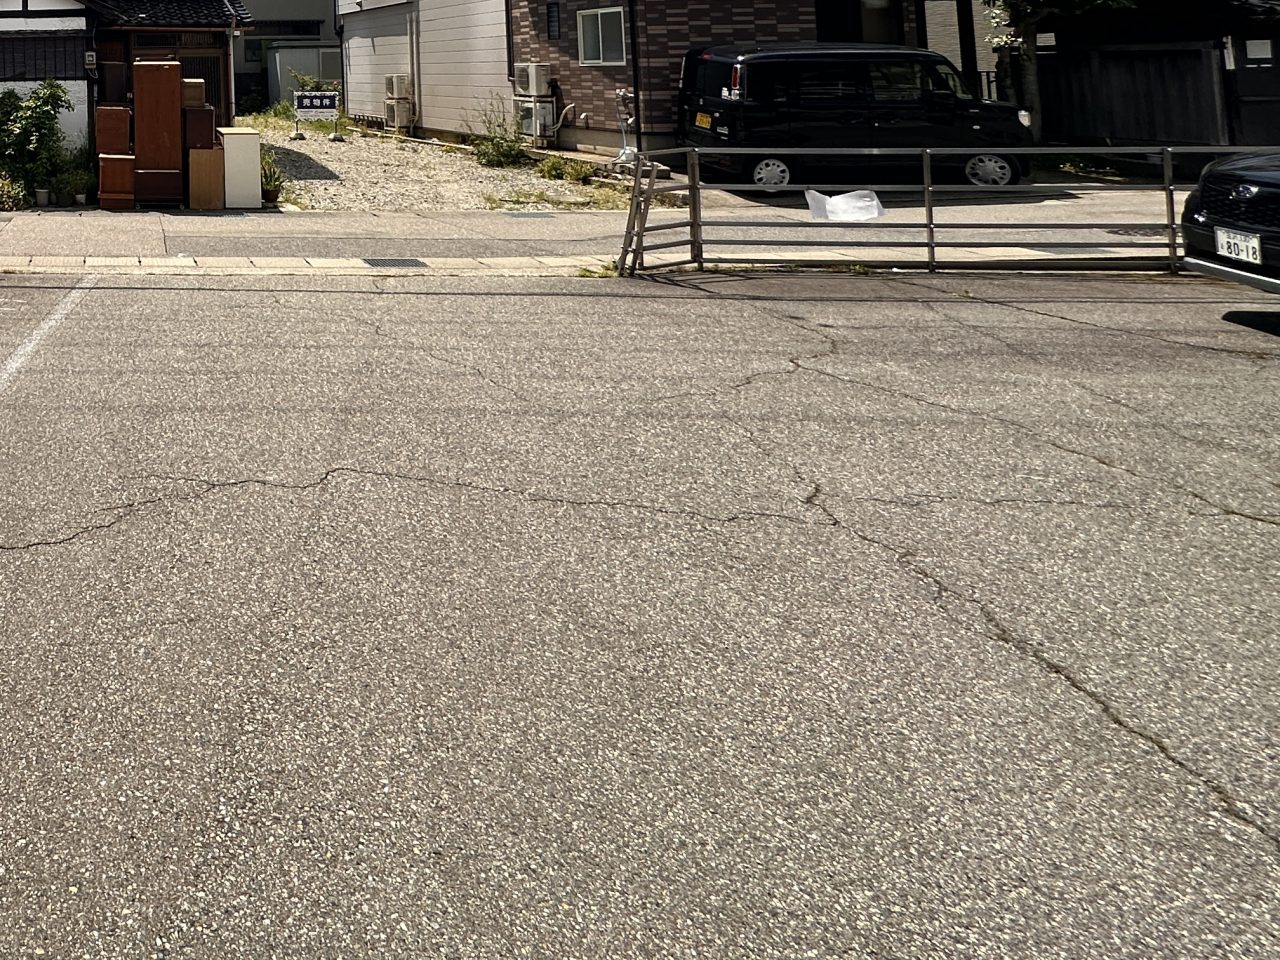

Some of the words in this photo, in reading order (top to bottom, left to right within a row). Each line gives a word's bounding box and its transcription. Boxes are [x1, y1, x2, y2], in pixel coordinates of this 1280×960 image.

[302, 98, 331, 107] 売物件
[1226, 240, 1258, 261] 80-18
